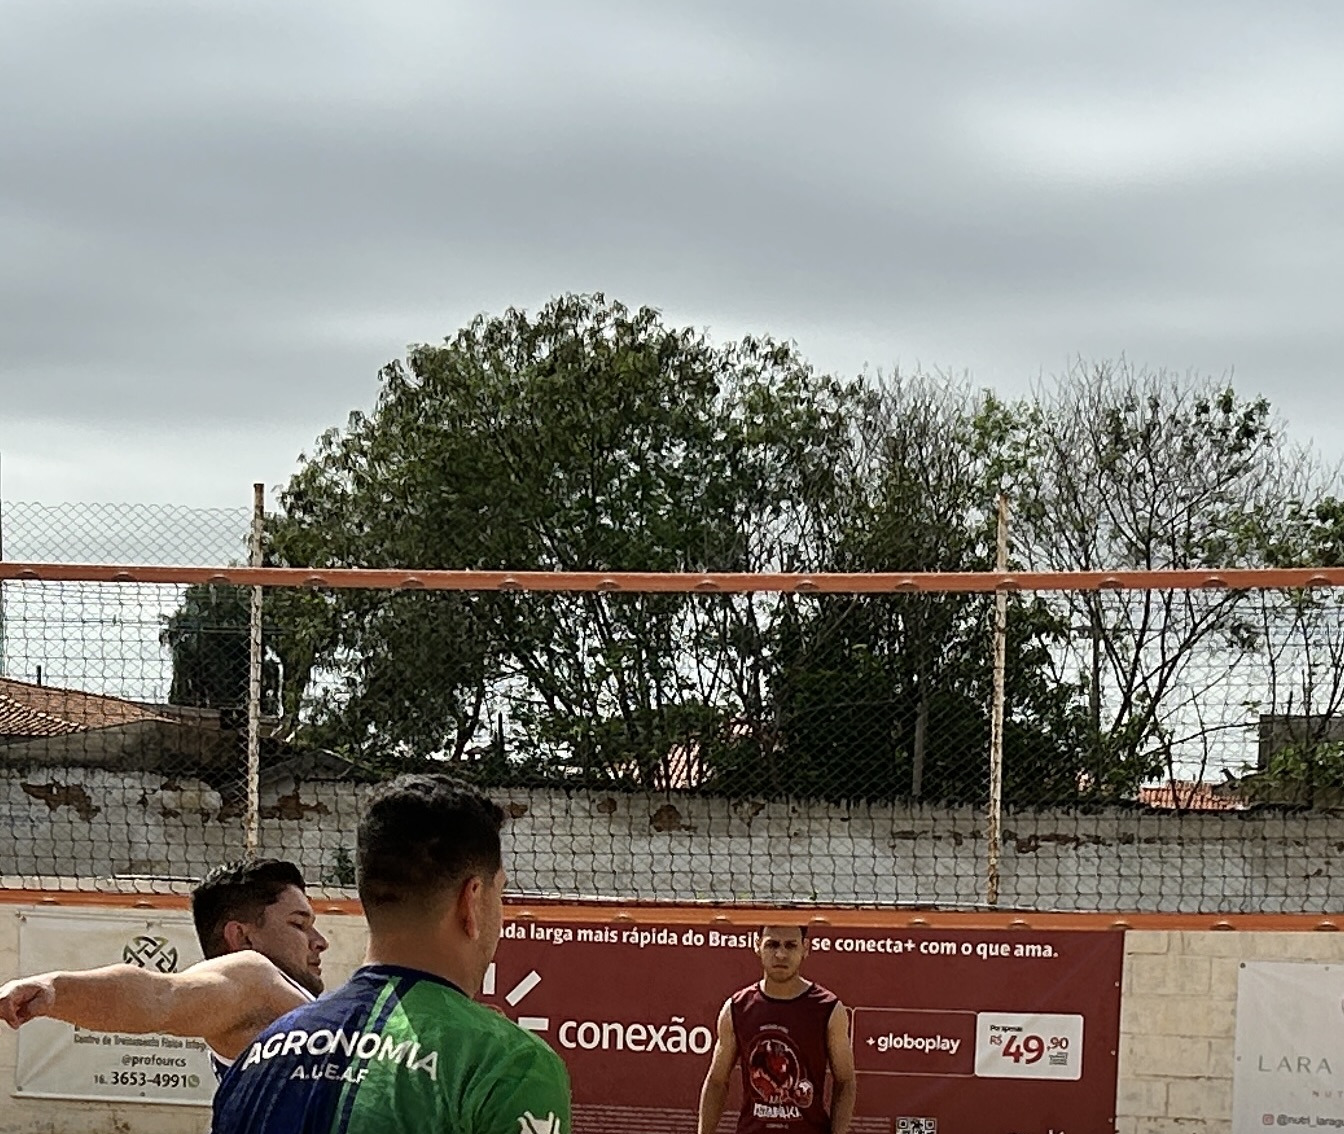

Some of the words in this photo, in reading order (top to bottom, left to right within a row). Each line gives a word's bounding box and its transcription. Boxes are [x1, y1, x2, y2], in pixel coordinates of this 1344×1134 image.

[500, 922, 526, 941] da
[530, 923, 573, 946] larga
[577, 928, 618, 943] mais
[622, 926, 679, 948] rápida
[681, 929, 705, 947] do
[811, 936, 831, 951] se
[834, 936, 916, 954] conecta+
[920, 941, 957, 956] com
[960, 943, 973, 957] o
[976, 943, 1011, 960] que
[1013, 942, 1059, 959] ama.
[558, 1016, 713, 1055] conexão
[241, 1028, 439, 1081] AGRONOMIA
[1257, 1055, 1333, 1075] LARA
[110, 1071, 187, 1088] 3653-4991
